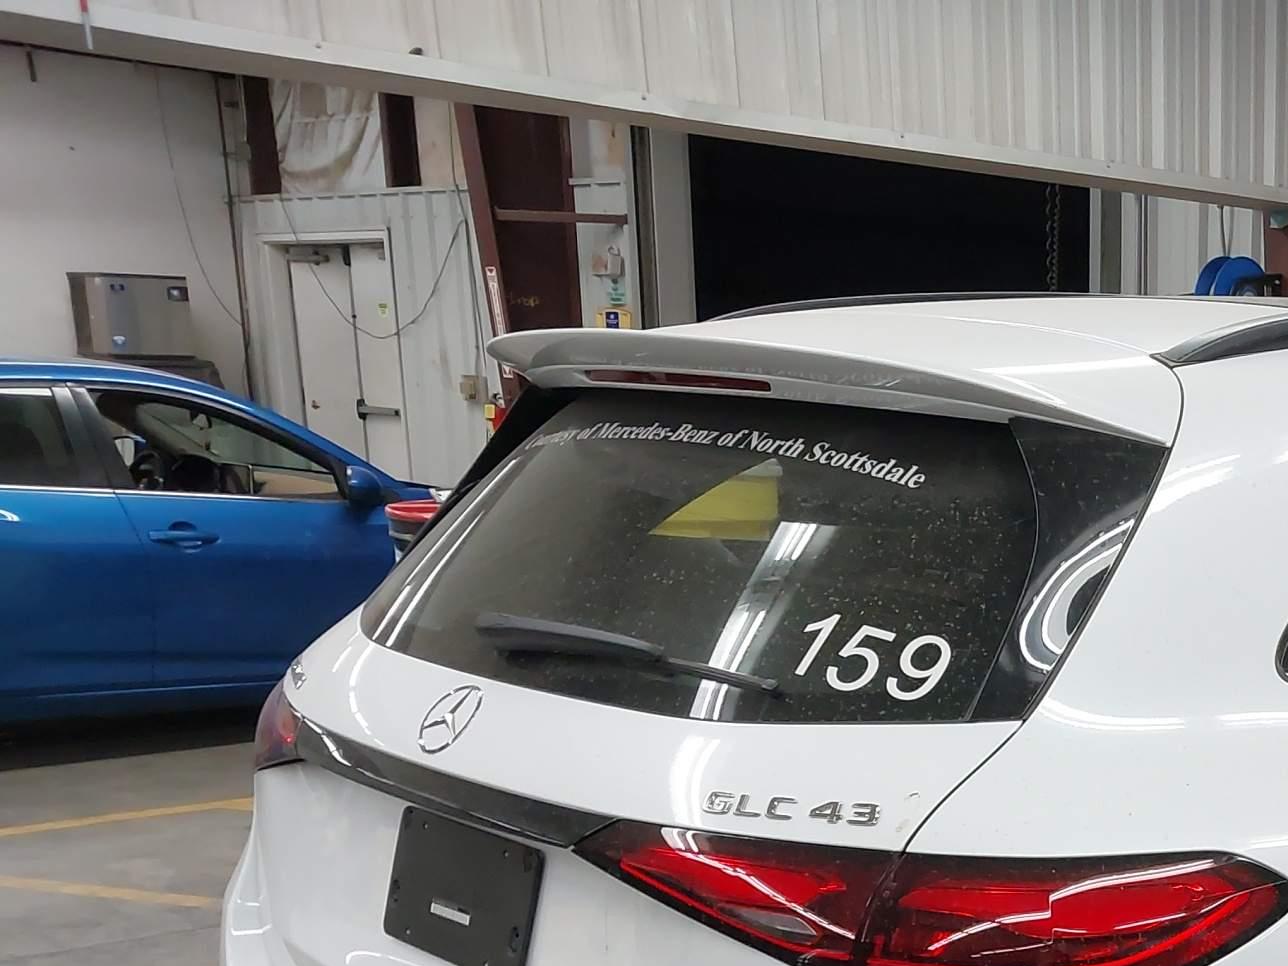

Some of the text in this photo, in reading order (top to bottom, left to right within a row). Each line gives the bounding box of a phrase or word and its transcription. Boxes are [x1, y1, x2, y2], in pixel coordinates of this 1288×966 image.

[576, 422, 604, 441] of
[592, 422, 720, 445] Mercedes-Benz
[717, 429, 749, 448] of
[739, 430, 805, 459] North
[803, 441, 926, 488] Scottsdale
[794, 613, 952, 701] 159
[702, 791, 881, 827] GLC 43
